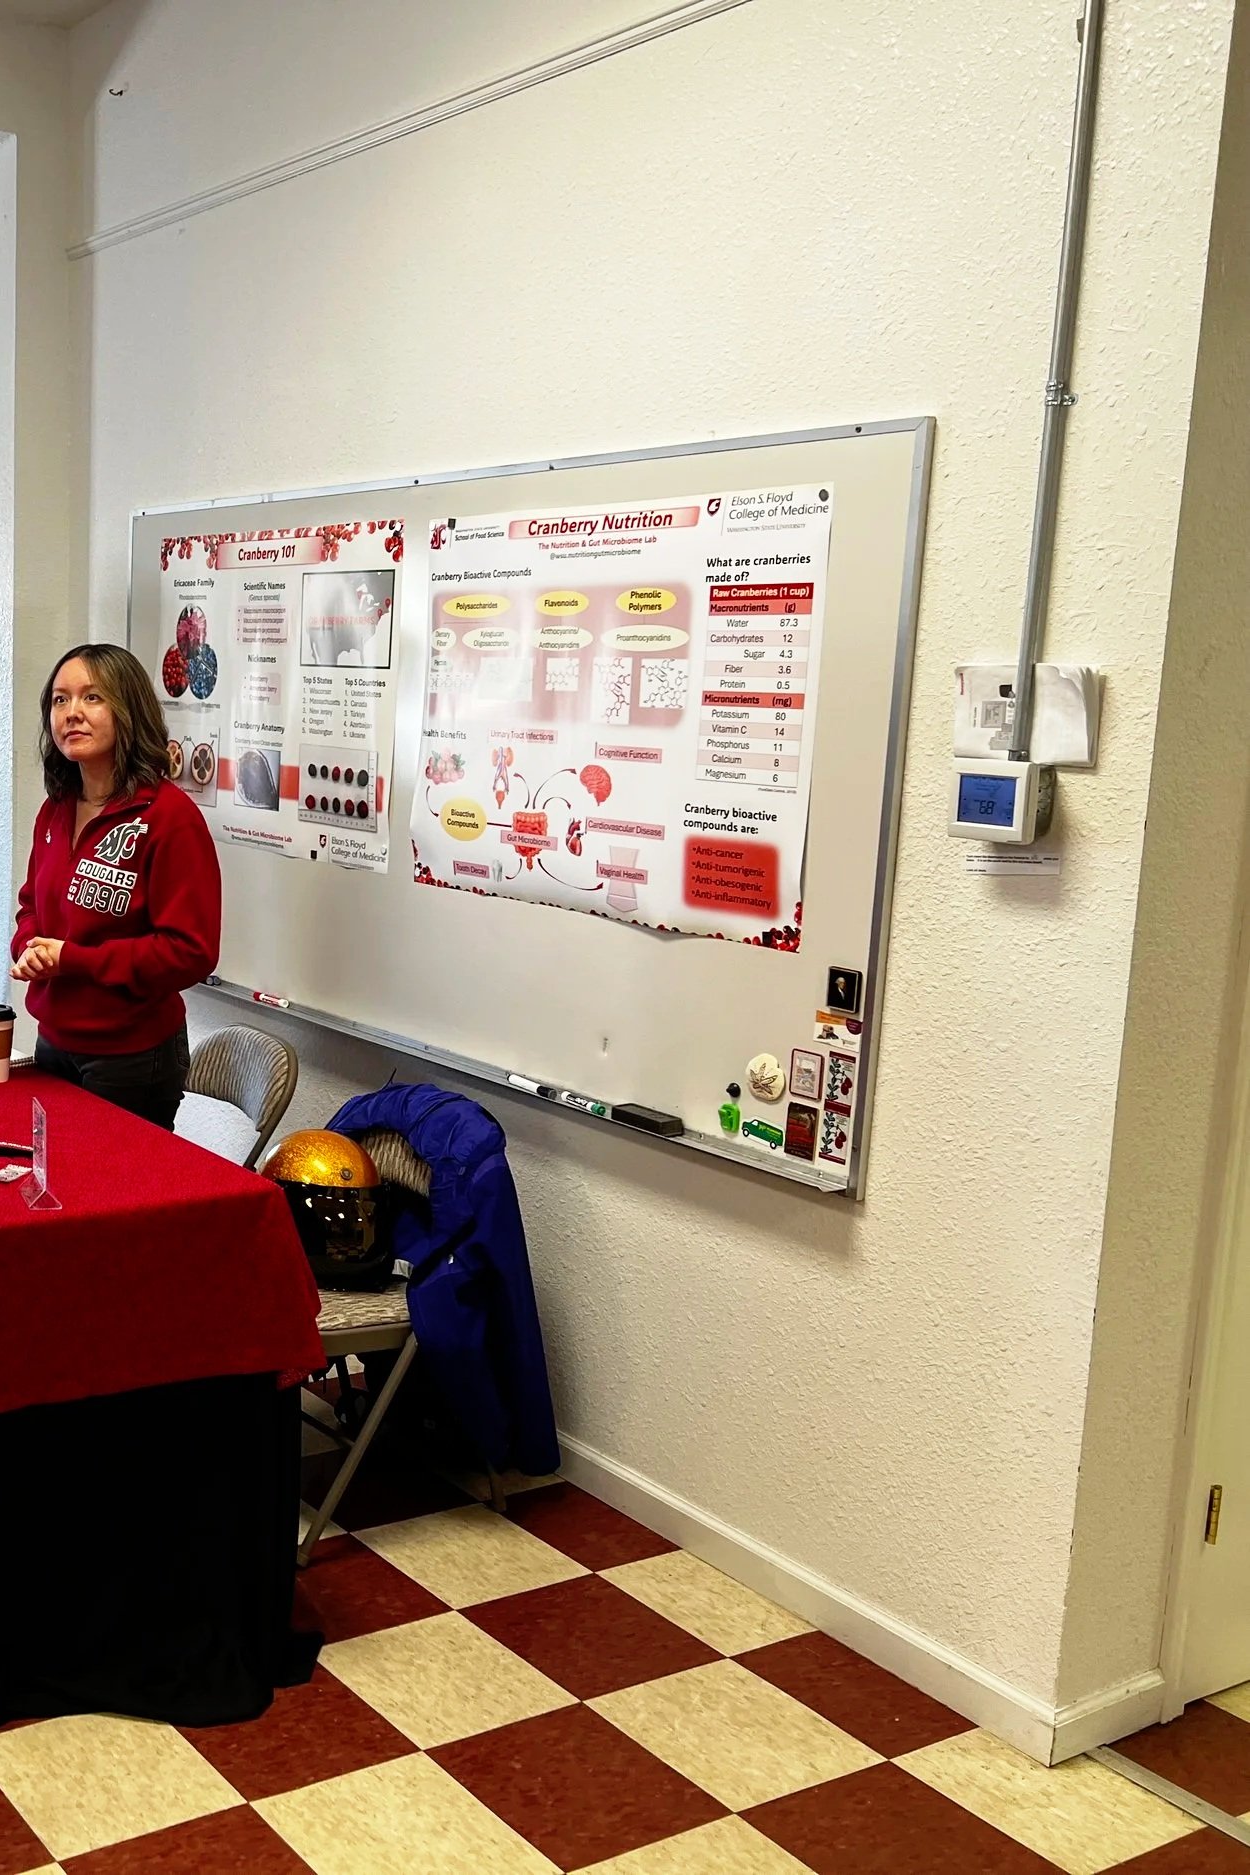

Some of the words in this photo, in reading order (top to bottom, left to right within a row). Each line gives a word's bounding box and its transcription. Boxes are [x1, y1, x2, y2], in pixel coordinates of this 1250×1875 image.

[731, 496, 756, 506] Elson
[766, 492, 794, 506] Floyd
[728, 509, 766, 521] College
[768, 506, 778, 517] of
[780, 504, 829, 516] Medicine
[528, 520, 599, 536] Cranberry
[601, 510, 673, 530] Nutrition
[455, 534, 469, 542] School
[475, 532, 486, 540] Food
[538, 542, 550, 550] The
[550, 540, 580, 550] Nutrition
[582, 540, 587, 548] &
[588, 538, 600, 548] Gut
[602, 536, 643, 546] Microbiome
[644, 535, 658, 544] Lab
[238, 547, 278, 562] Cranberry
[282, 545, 296, 558] 101
[550, 548, 642, 560] @wsu.nutritiongutmicrobiome
[706, 557, 732, 568] What
[734, 558, 750, 566] are
[753, 554, 811, 566] cranberries
[432, 572, 463, 582] Cranberry
[464, 570, 492, 580] Bioactive
[492, 567, 532, 579] Compounds
[705, 572, 734, 582] made
[734, 571, 750, 582] of?
[174, 580, 196, 588] Ericaceae
[197, 578, 214, 588] Family
[244, 582, 267, 590] Scientific
[268, 582, 286, 590] Names
[630, 590, 662, 600] Phenolic
[712, 588, 730, 598] Raw
[730, 588, 778, 597] Cranberries
[780, 586, 788, 598] (1
[789, 586, 810, 598] cup)
[456, 602, 498, 611] Polysaccharides
[544, 598, 578, 608] Flavonoids
[628, 602, 662, 612] Polymers
[710, 604, 769, 612] Macronutrients
[784, 602, 796, 614] (g)
[726, 619, 749, 628] Water
[780, 618, 798, 628] 87.3
[540, 626, 580, 636] Anthocyanins/
[616, 633, 672, 643] Proanthocyanidins
[710, 634, 764, 644] Carbohydrates
[783, 634, 793, 643] 12
[538, 640, 580, 650] Anthocyanidins
[248, 654, 276, 664] Nicknames
[744, 649, 766, 660] Sugar
[779, 650, 793, 658] 4.3
[724, 664, 744, 674] Fiber
[778, 666, 792, 674] 3.6
[303, 676, 312, 685] Top
[312, 676, 316, 684] 5
[316, 676, 332, 685] States
[344, 678, 354, 686] Top
[354, 678, 358, 686] 5
[358, 678, 386, 688] Countries
[720, 680, 746, 688] Protein
[776, 680, 790, 690] 0.5
[704, 694, 760, 704] Micronutrients
[772, 696, 792, 708] (mg)
[711, 709, 750, 719] Potassium
[775, 712, 786, 720] 80
[234, 720, 260, 732] Cranberry
[261, 723, 285, 734] Anatomy
[712, 724, 740, 734] Vitamin
[740, 726, 748, 734] C
[774, 728, 784, 736] 14
[422, 729, 439, 738] Health
[440, 730, 466, 740] Benefits
[490, 730, 510, 740] Urinary
[510, 730, 525, 740] Tract
[526, 732, 554, 742] Infections
[706, 738, 750, 750] Phosphorus
[774, 744, 783, 752] 11
[598, 748, 628, 760] Cognitive
[629, 751, 658, 760] Function
[711, 754, 742, 764] Calcium
[774, 758, 780, 768] 8
[704, 768, 746, 780] Magnesium
[772, 774, 778, 782] 6
[450, 808, 476, 818] Bioactive
[684, 803, 730, 819] Cranberry
[732, 808, 778, 822] bioactive
[978, 800, 995, 815] 68
[446, 818, 479, 830] Compounds
[588, 820, 636, 834] Cardiovascular
[636, 825, 662, 837] Disease
[683, 820, 738, 832] compounds
[740, 825, 758, 834] are:
[331, 836, 345, 846] Elson
[350, 840, 366, 850] Floyd
[506, 834, 518, 842] Gut
[518, 835, 551, 848] Microbiome
[330, 846, 351, 859] College
[352, 850, 358, 858] of
[359, 851, 387, 864] Medicine
[695, 846, 744, 860] Anti-cancer
[77, 860, 136, 887] COUGARS
[456, 864, 470, 873] Tooth
[470, 866, 487, 877] Decay
[600, 867, 622, 880] Vaginal
[622, 870, 645, 880] Health
[694, 860, 766, 878] Anti-tumorigenic
[67, 877, 82, 901] EST.
[694, 875, 763, 892] Anti-obesogenic
[75, 878, 132, 916] 1890
[694, 889, 771, 910] Anti-inflammatory
